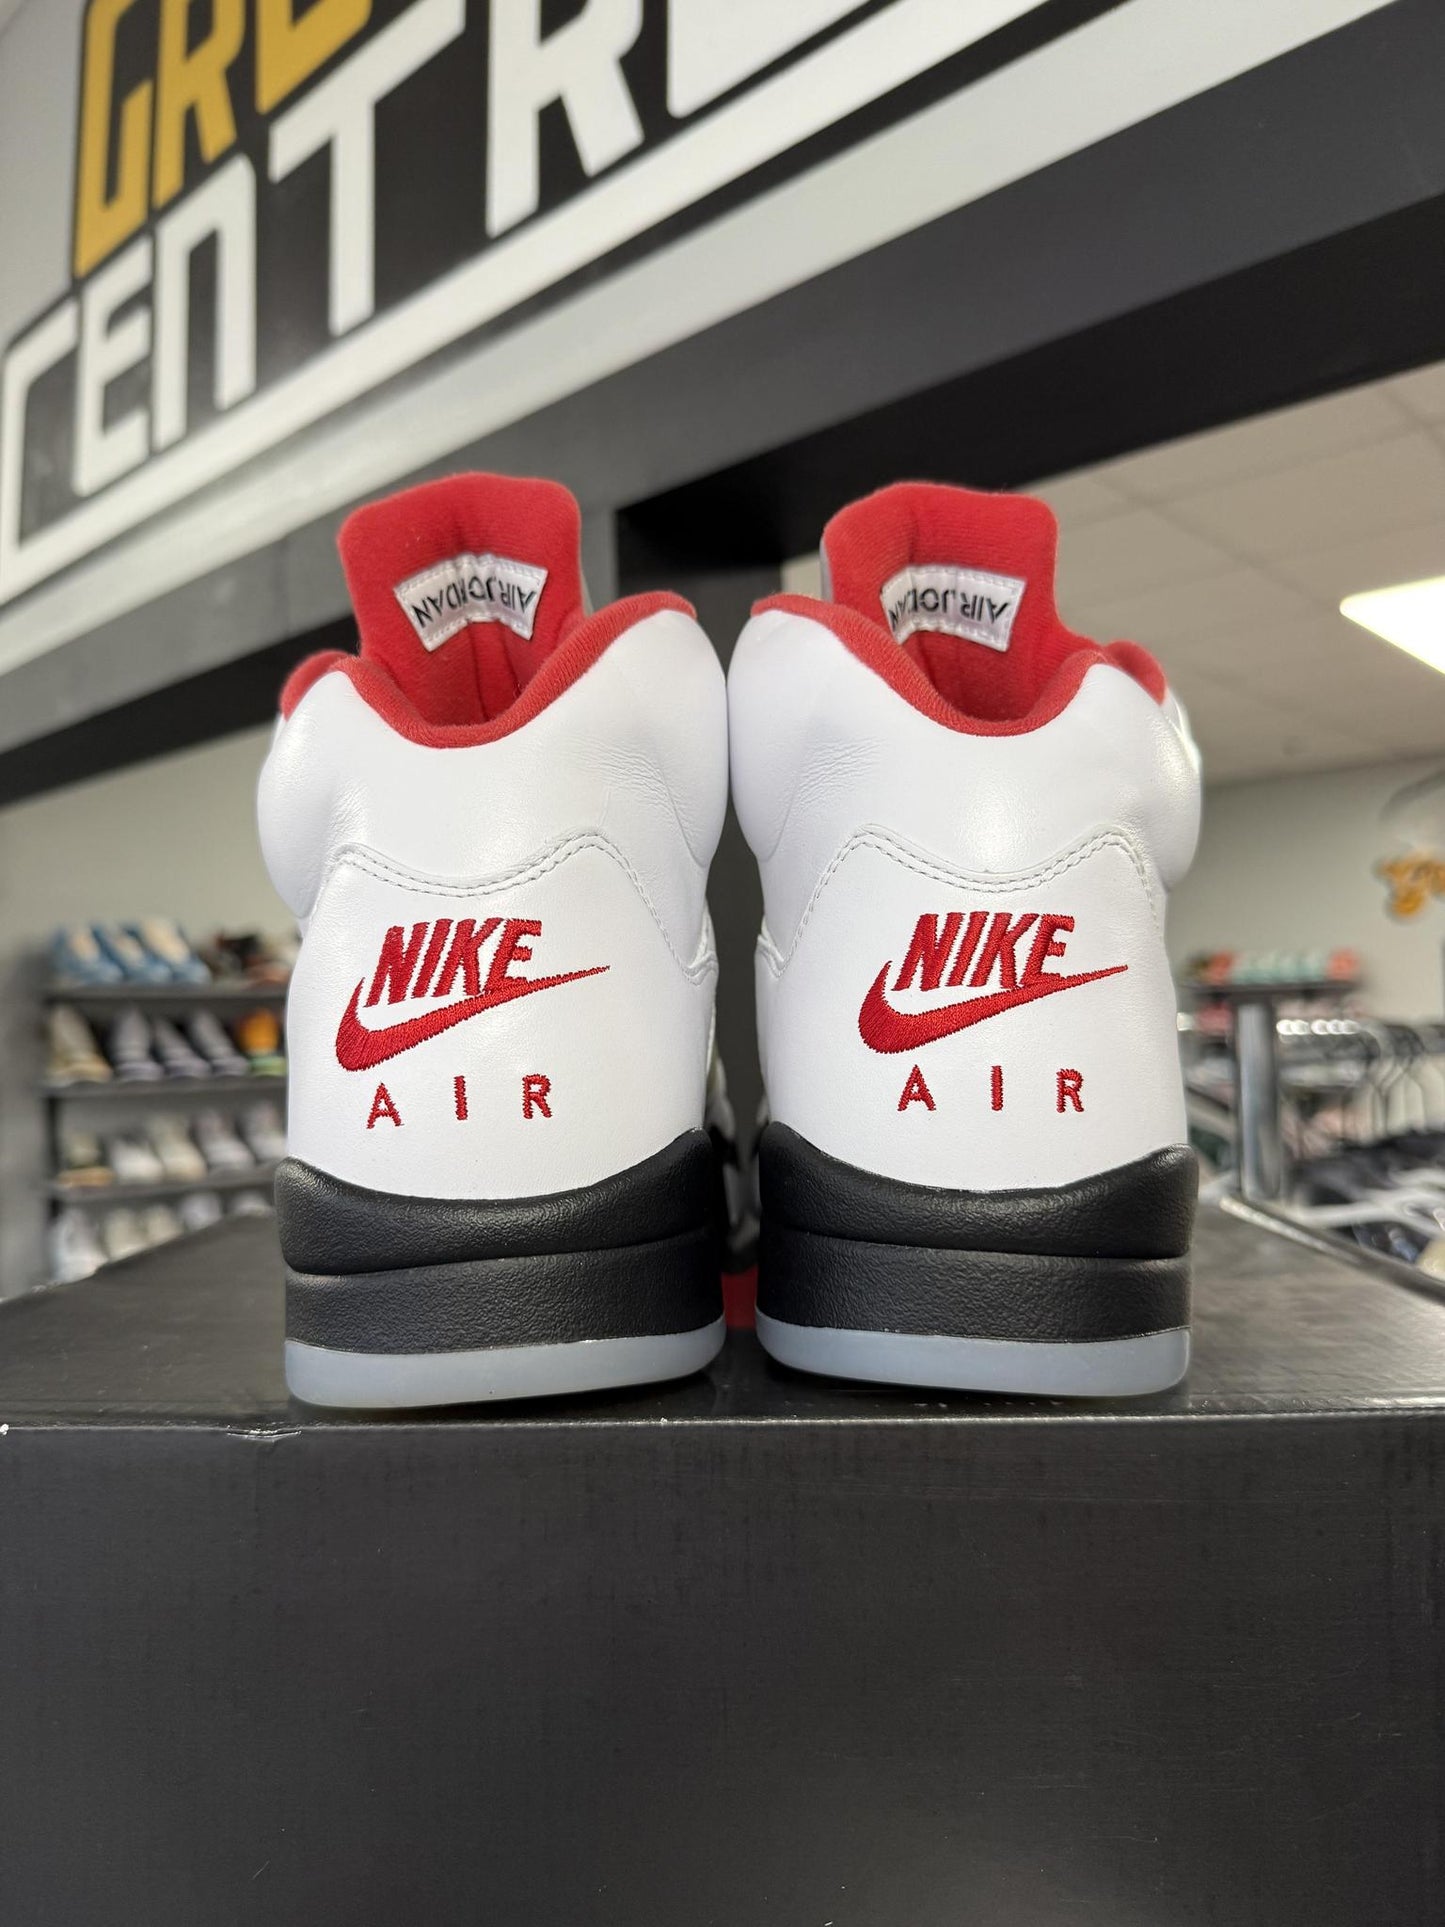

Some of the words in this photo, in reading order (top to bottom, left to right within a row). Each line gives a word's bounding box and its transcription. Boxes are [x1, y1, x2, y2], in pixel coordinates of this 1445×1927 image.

[498, 578, 537, 614] AIR
[958, 591, 1010, 624] AIR
[363, 916, 542, 1008] NIKE
[890, 910, 1076, 992] NIKE
[366, 1073, 553, 1130] AIR
[896, 1063, 1085, 1114] AIR
